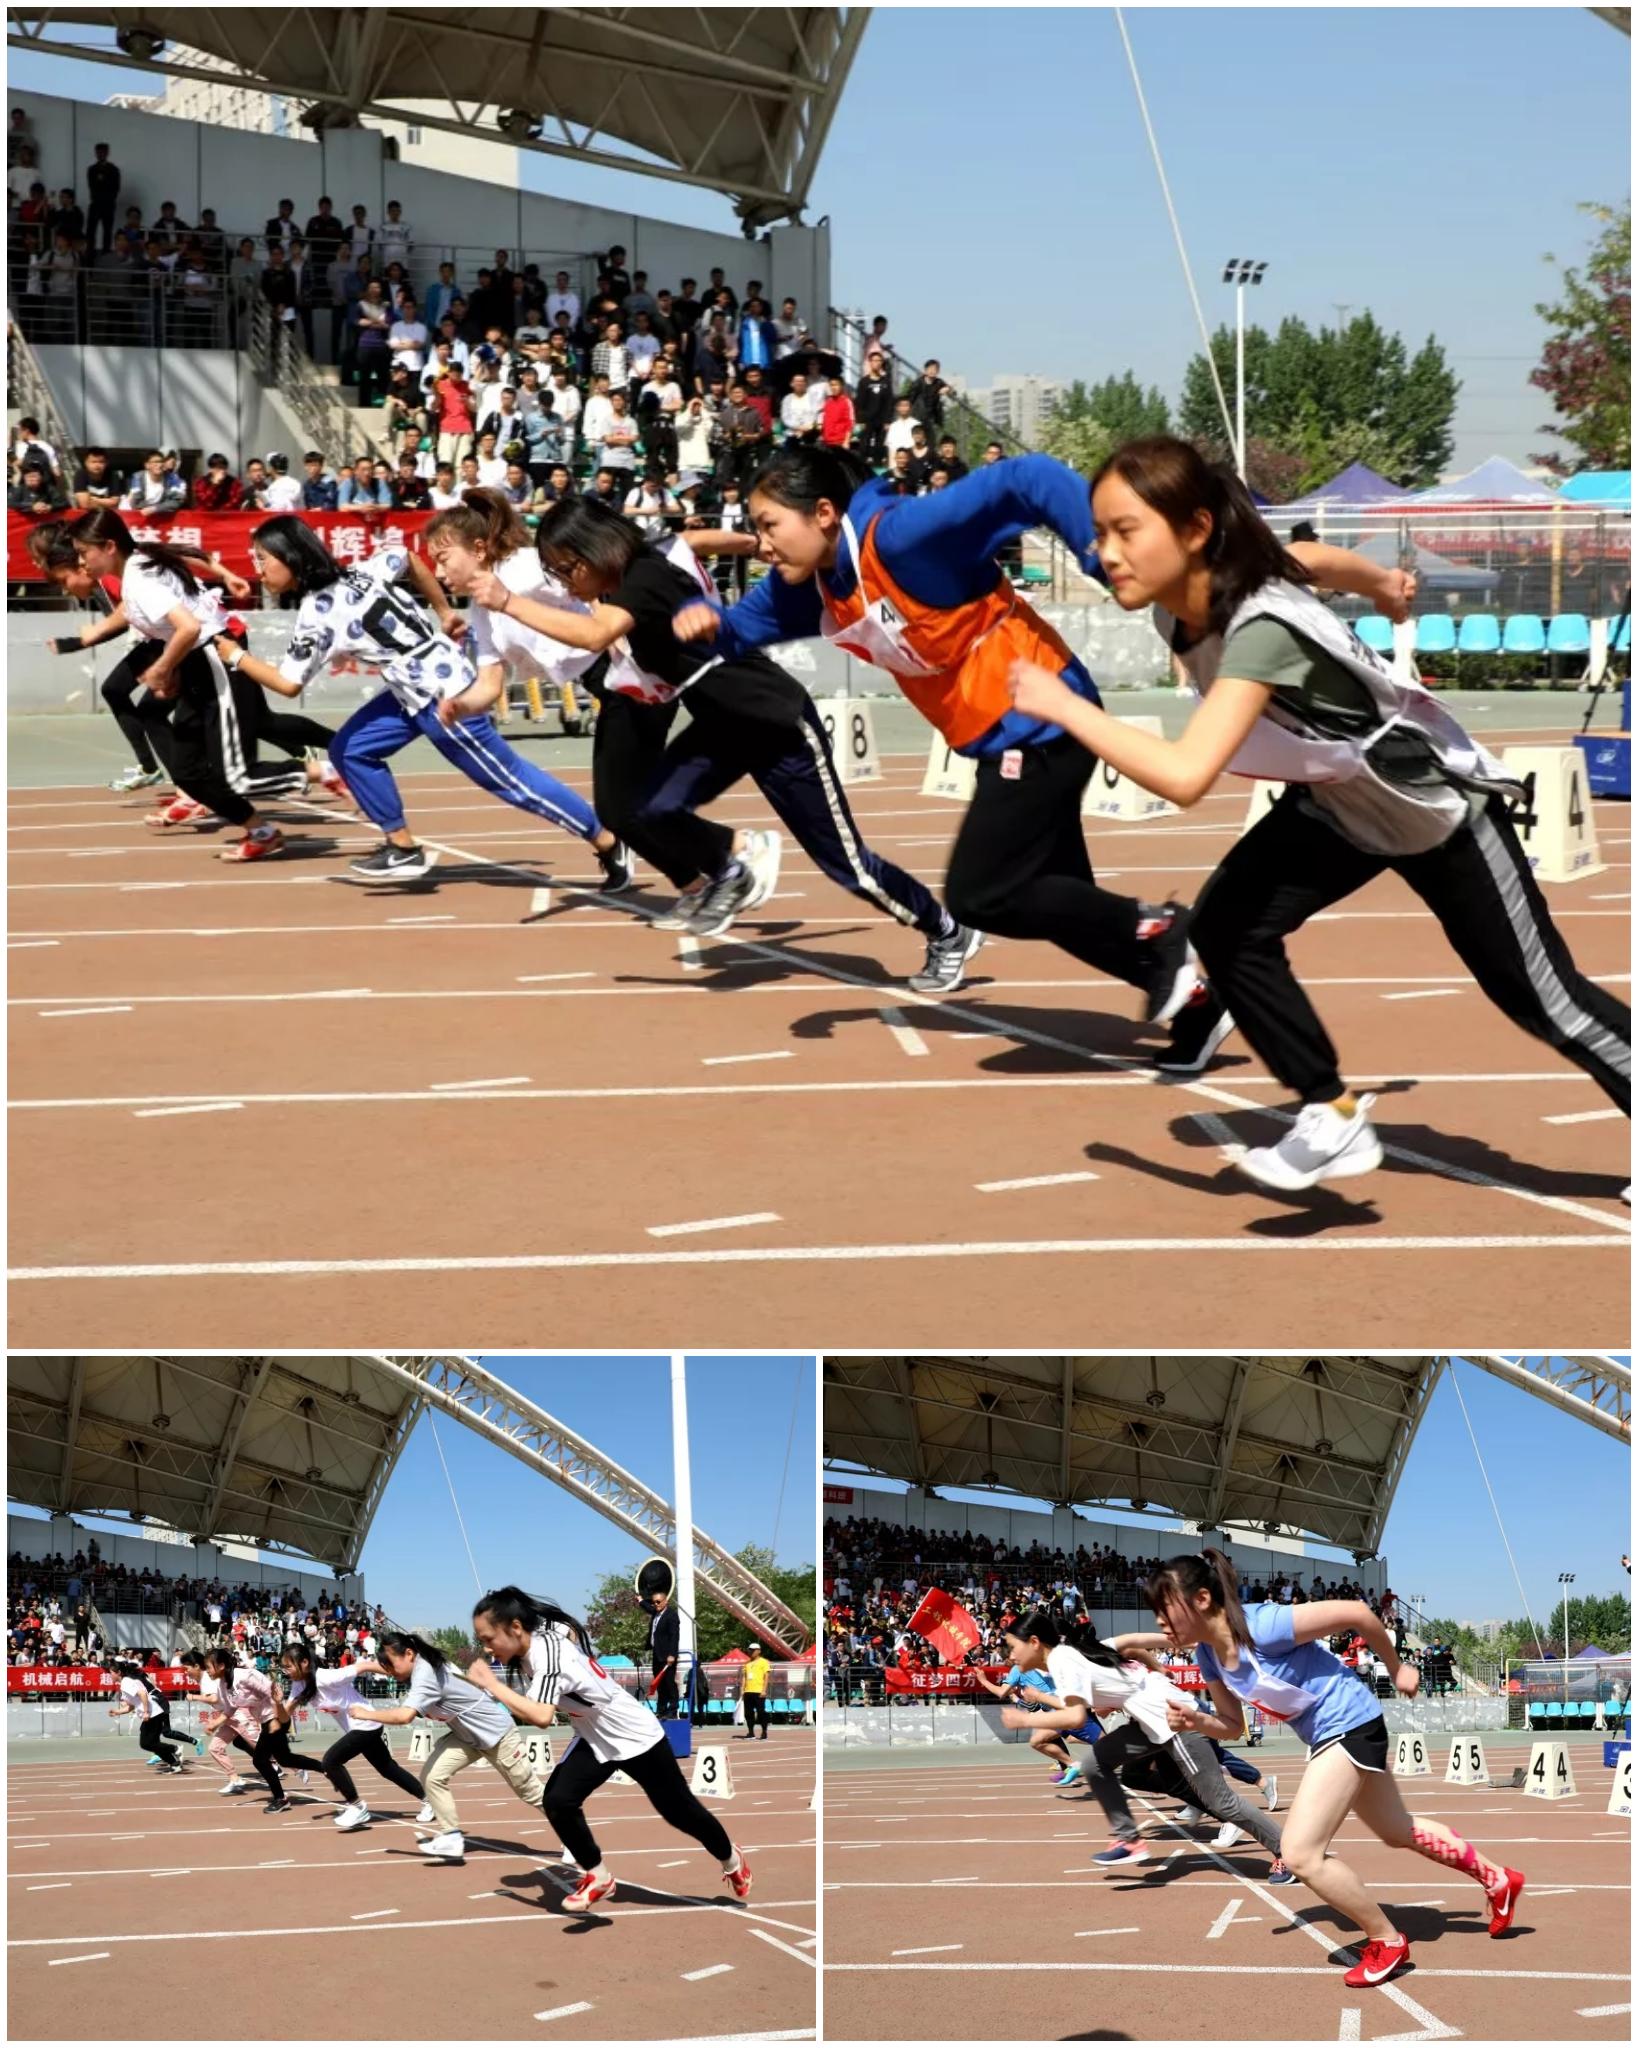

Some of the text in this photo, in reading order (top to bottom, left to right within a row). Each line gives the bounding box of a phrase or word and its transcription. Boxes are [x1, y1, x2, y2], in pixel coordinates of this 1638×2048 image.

[851, 713, 868, 760] 8
[1569, 770, 1584, 841] 4
[414, 1735, 421, 1752] 7
[425, 1735, 431, 1753] 7
[528, 1742, 538, 1763] 5
[544, 1741, 551, 1763] 5
[1399, 1740, 1406, 1763] 6
[1413, 1740, 1423, 1763] 6
[702, 1755, 717, 1784] 3
[1452, 1744, 1462, 1771] 5
[1470, 1744, 1481, 1771] 5
[1533, 1751, 1545, 1783] 4
[1557, 1751, 1567, 1783] 4
